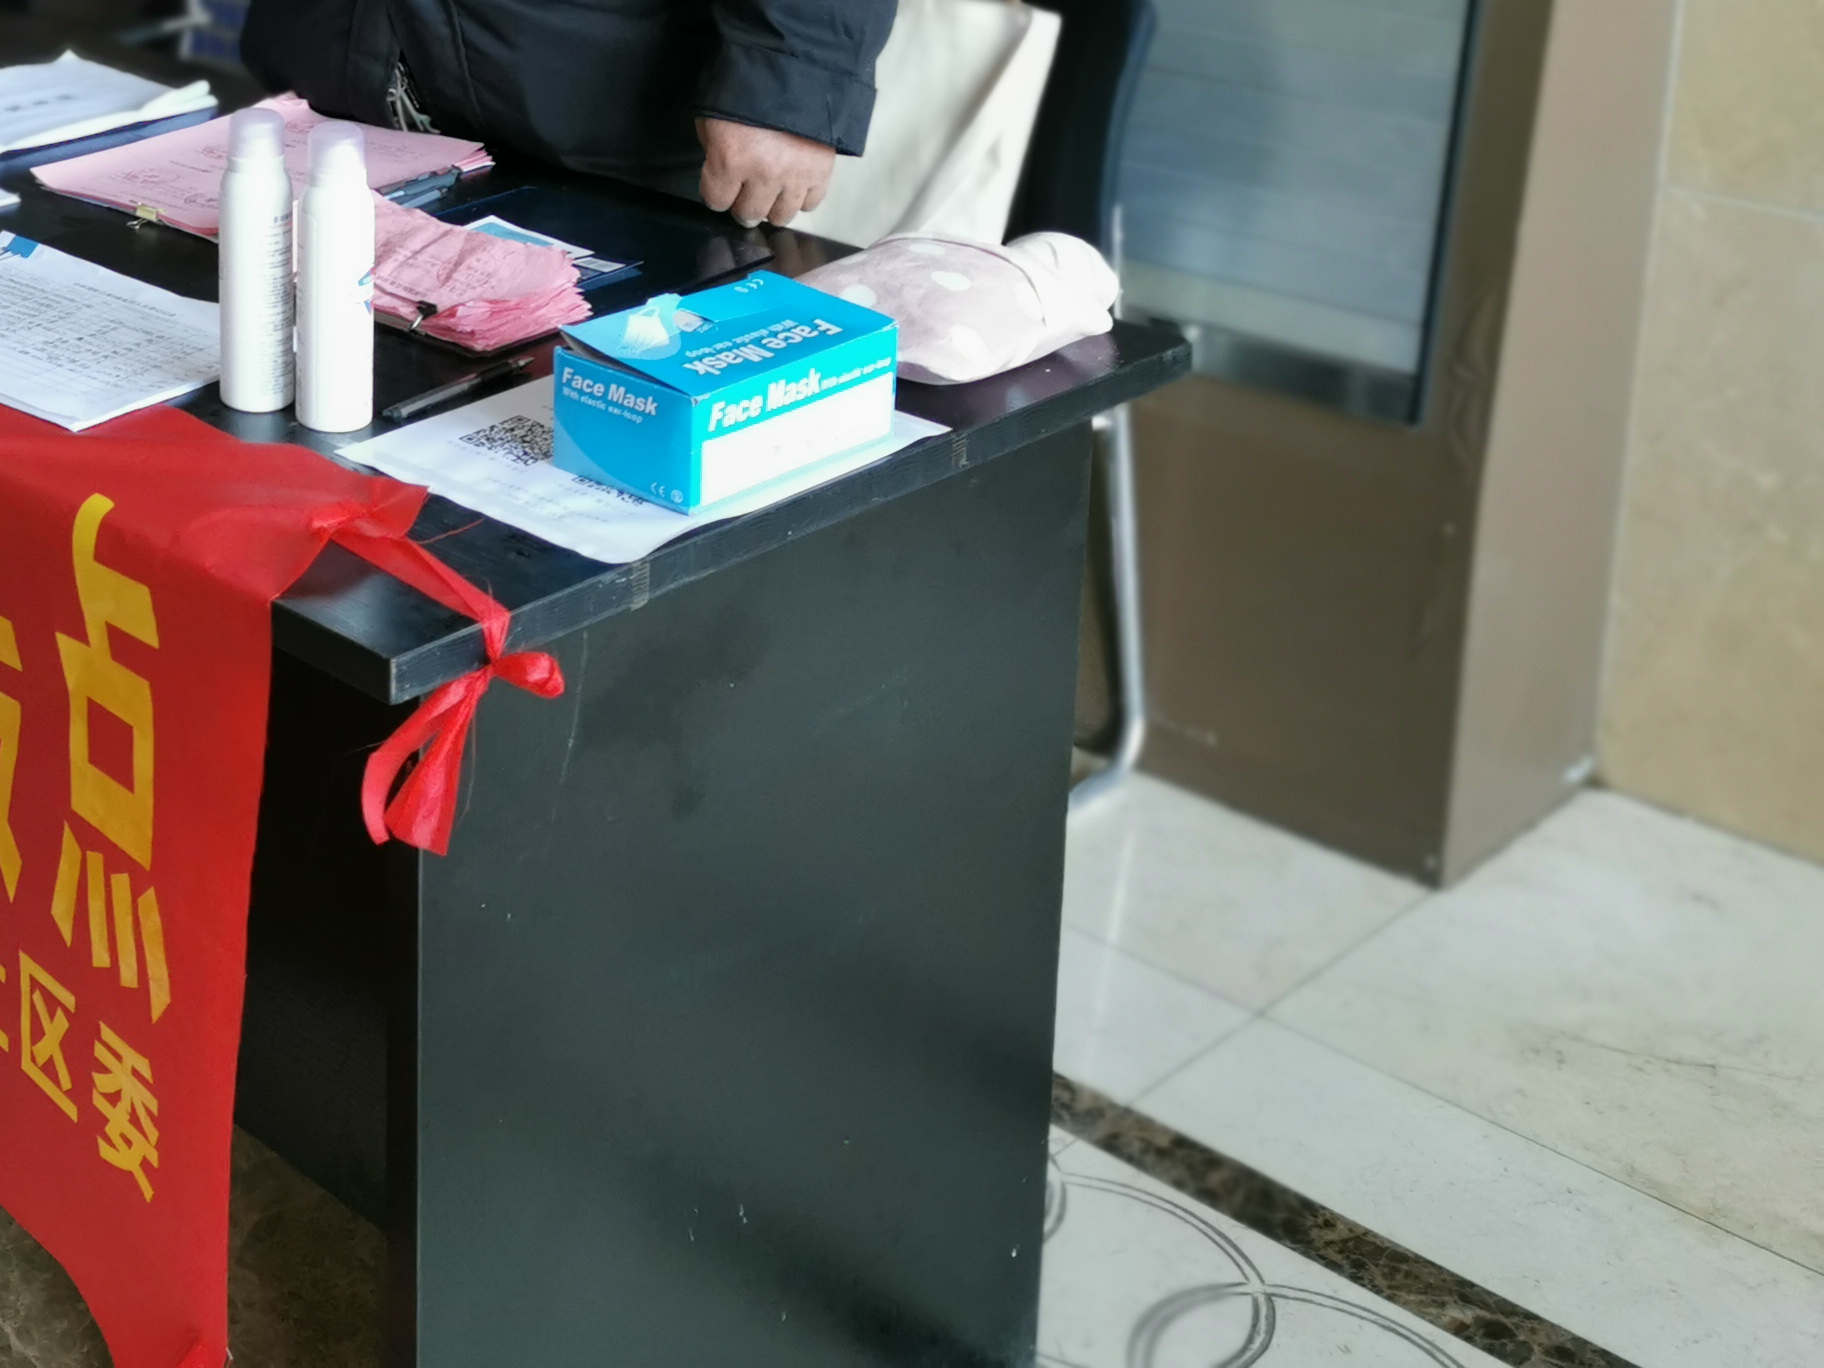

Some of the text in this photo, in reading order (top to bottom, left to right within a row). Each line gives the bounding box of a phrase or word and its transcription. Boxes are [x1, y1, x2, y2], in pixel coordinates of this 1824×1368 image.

[682, 318, 844, 375] Face Mask
[562, 366, 659, 416] Face Mask
[708, 395, 764, 432] Face
[766, 368, 822, 412] Mask
